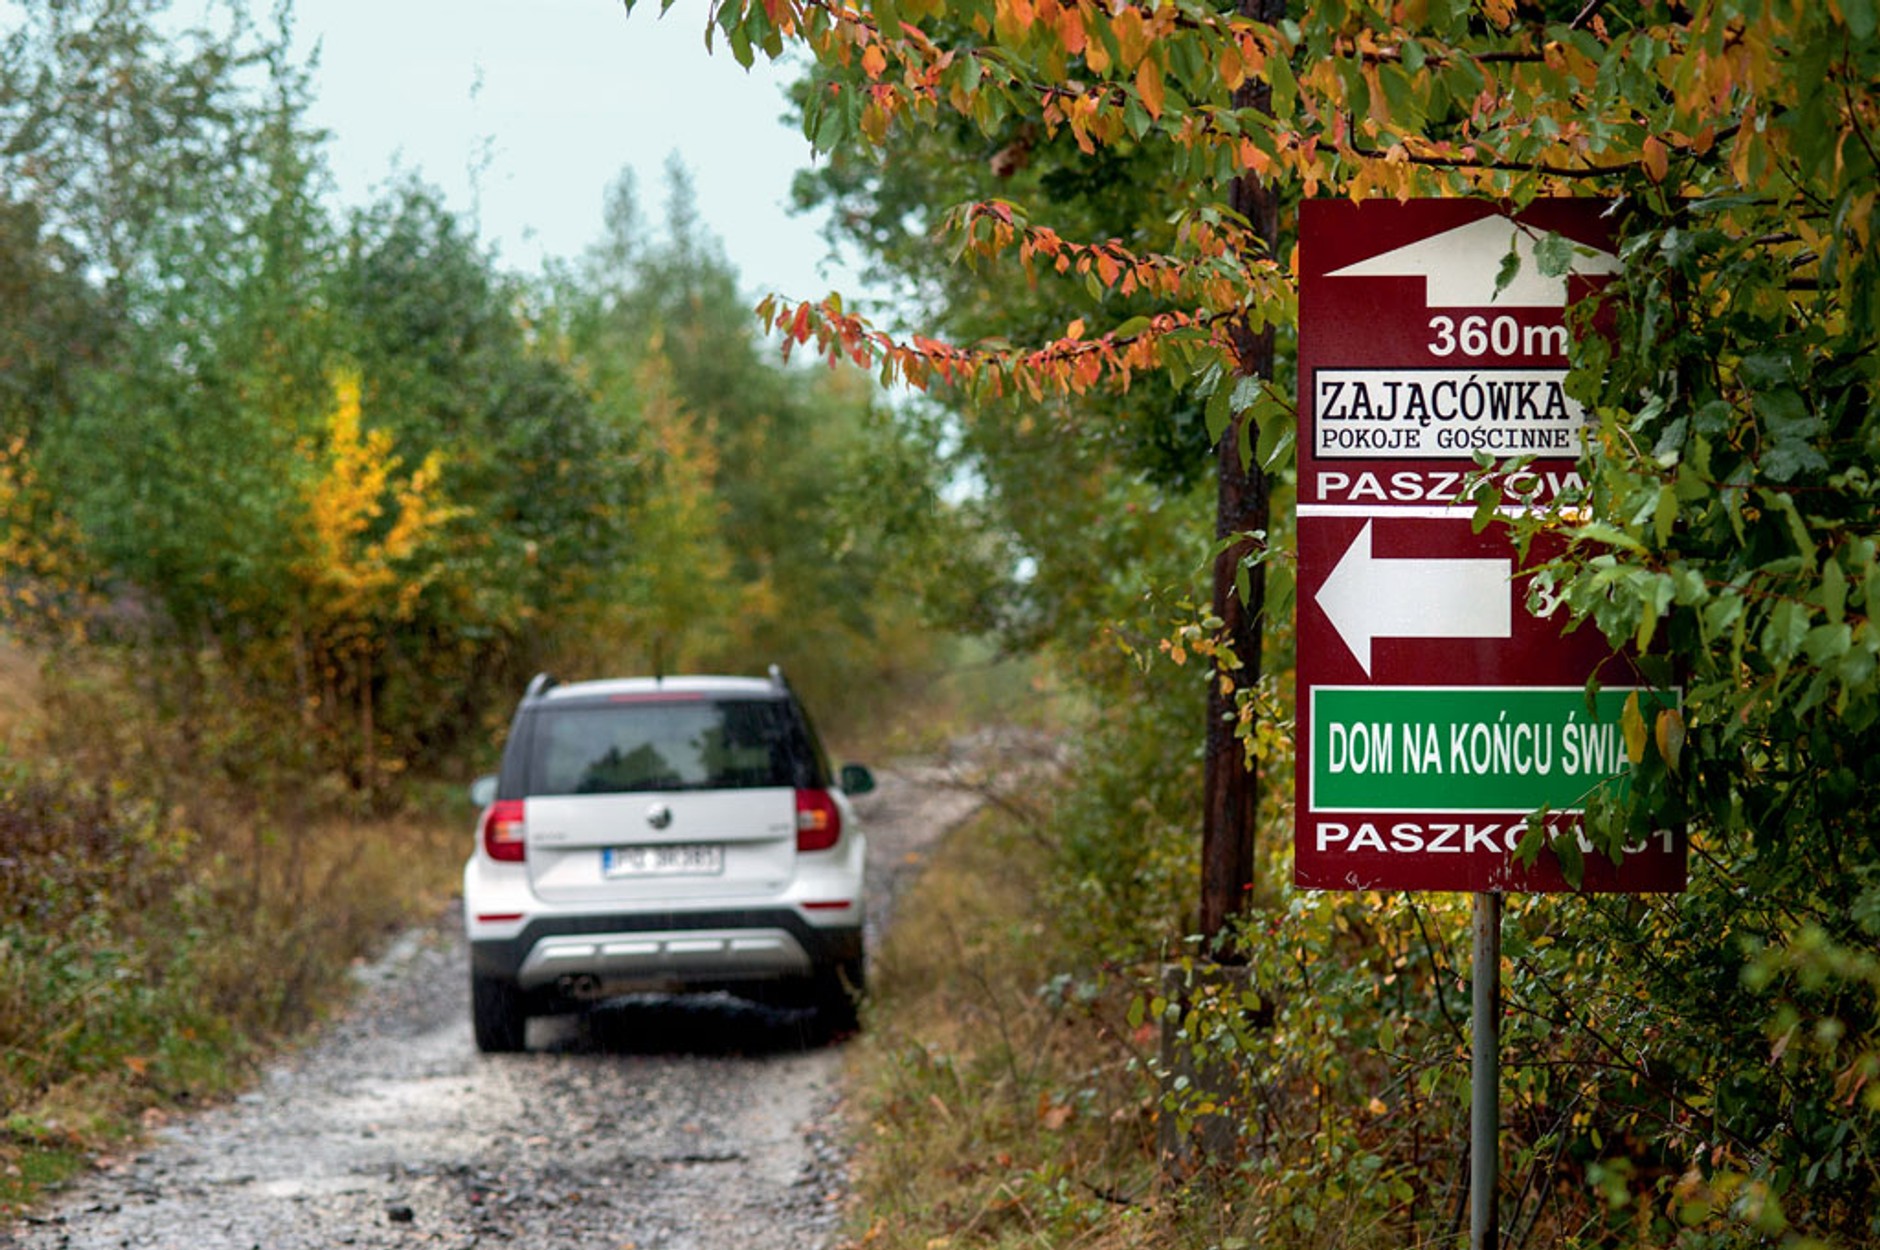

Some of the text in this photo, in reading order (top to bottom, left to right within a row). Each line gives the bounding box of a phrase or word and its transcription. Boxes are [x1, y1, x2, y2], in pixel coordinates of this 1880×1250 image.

[1427, 315, 1568, 356] 360m
[1321, 374, 1570, 427] ZAJĄCÓWKA
[1322, 425, 1570, 449] POKOJE GOŚCINNE
[1329, 722, 1393, 775] DOM
[1403, 722, 1442, 775] NA
[1450, 711, 1552, 776] KOŃCU
